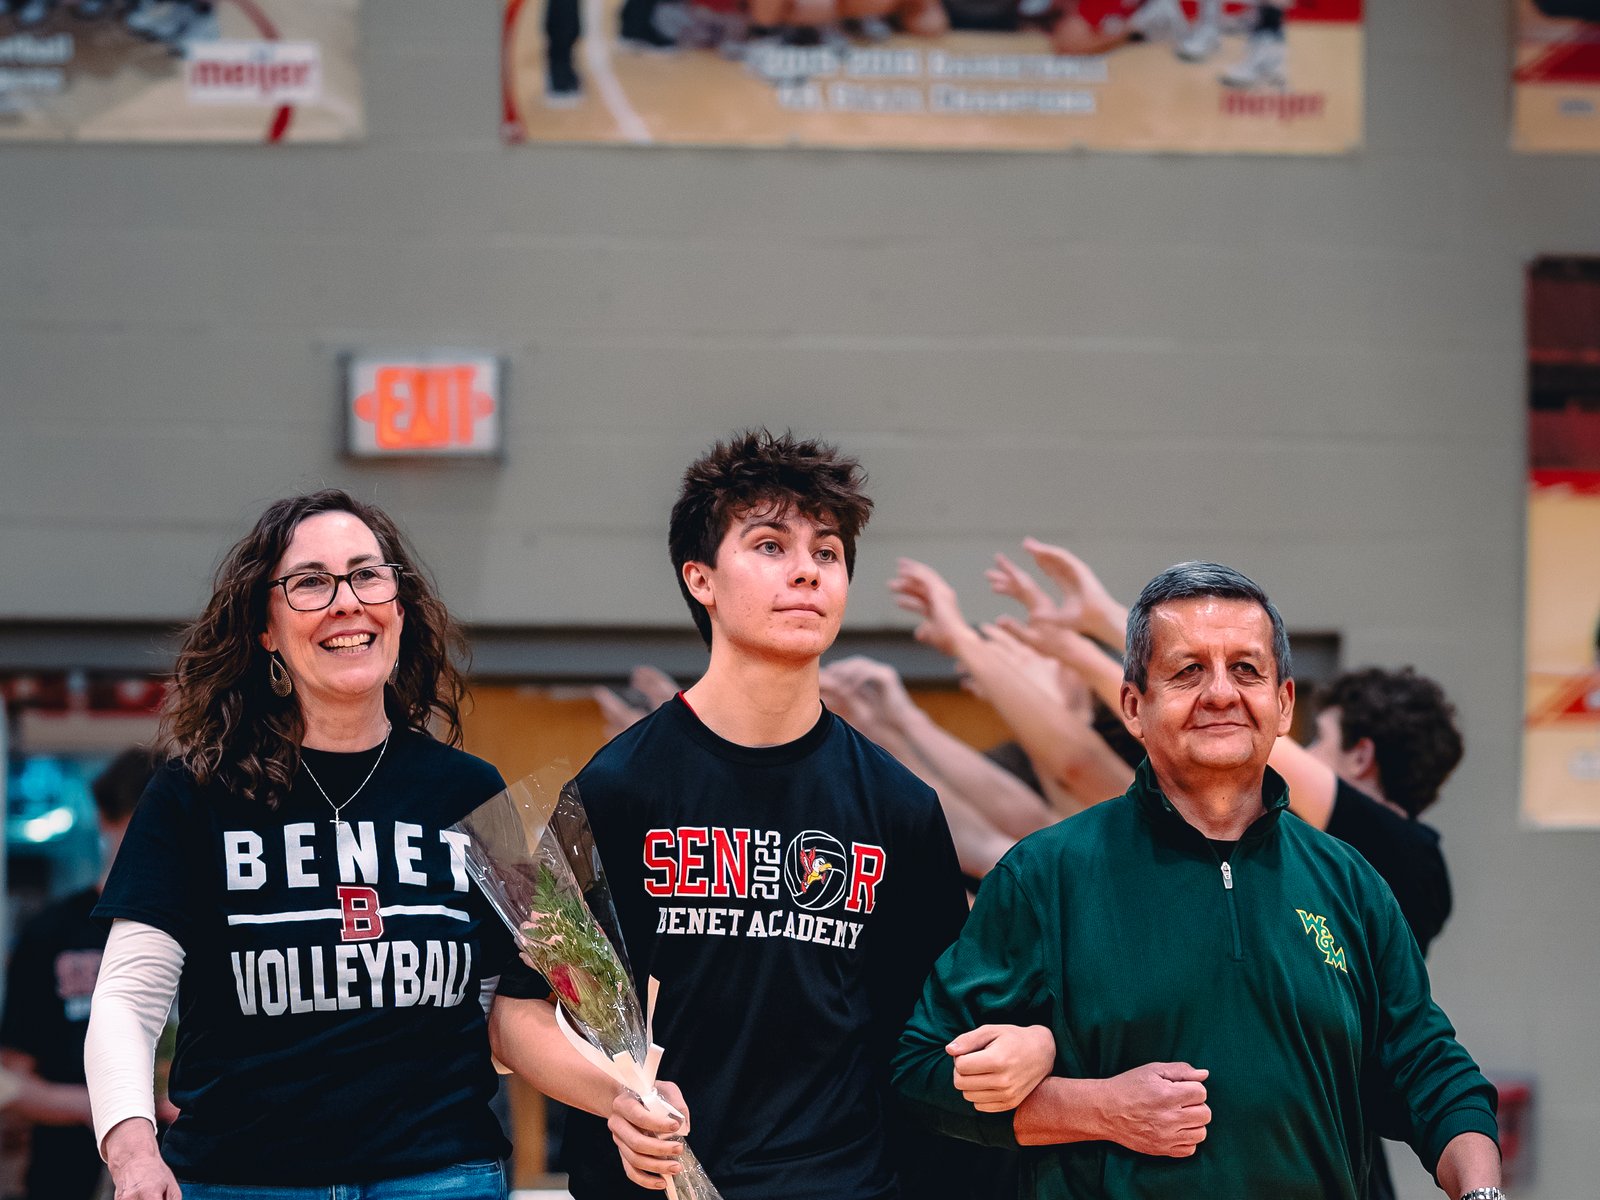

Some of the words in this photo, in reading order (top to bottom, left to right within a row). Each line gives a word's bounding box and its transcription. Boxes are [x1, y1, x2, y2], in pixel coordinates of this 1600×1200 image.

[375, 364, 475, 449] EXIT
[223, 821, 472, 893] BENET
[751, 829, 781, 900] 2025
[336, 885, 385, 942] B
[656, 906, 745, 937] BENET
[746, 909, 865, 950] ACADEMY
[230, 940, 472, 1017] VOLLEYBALL
